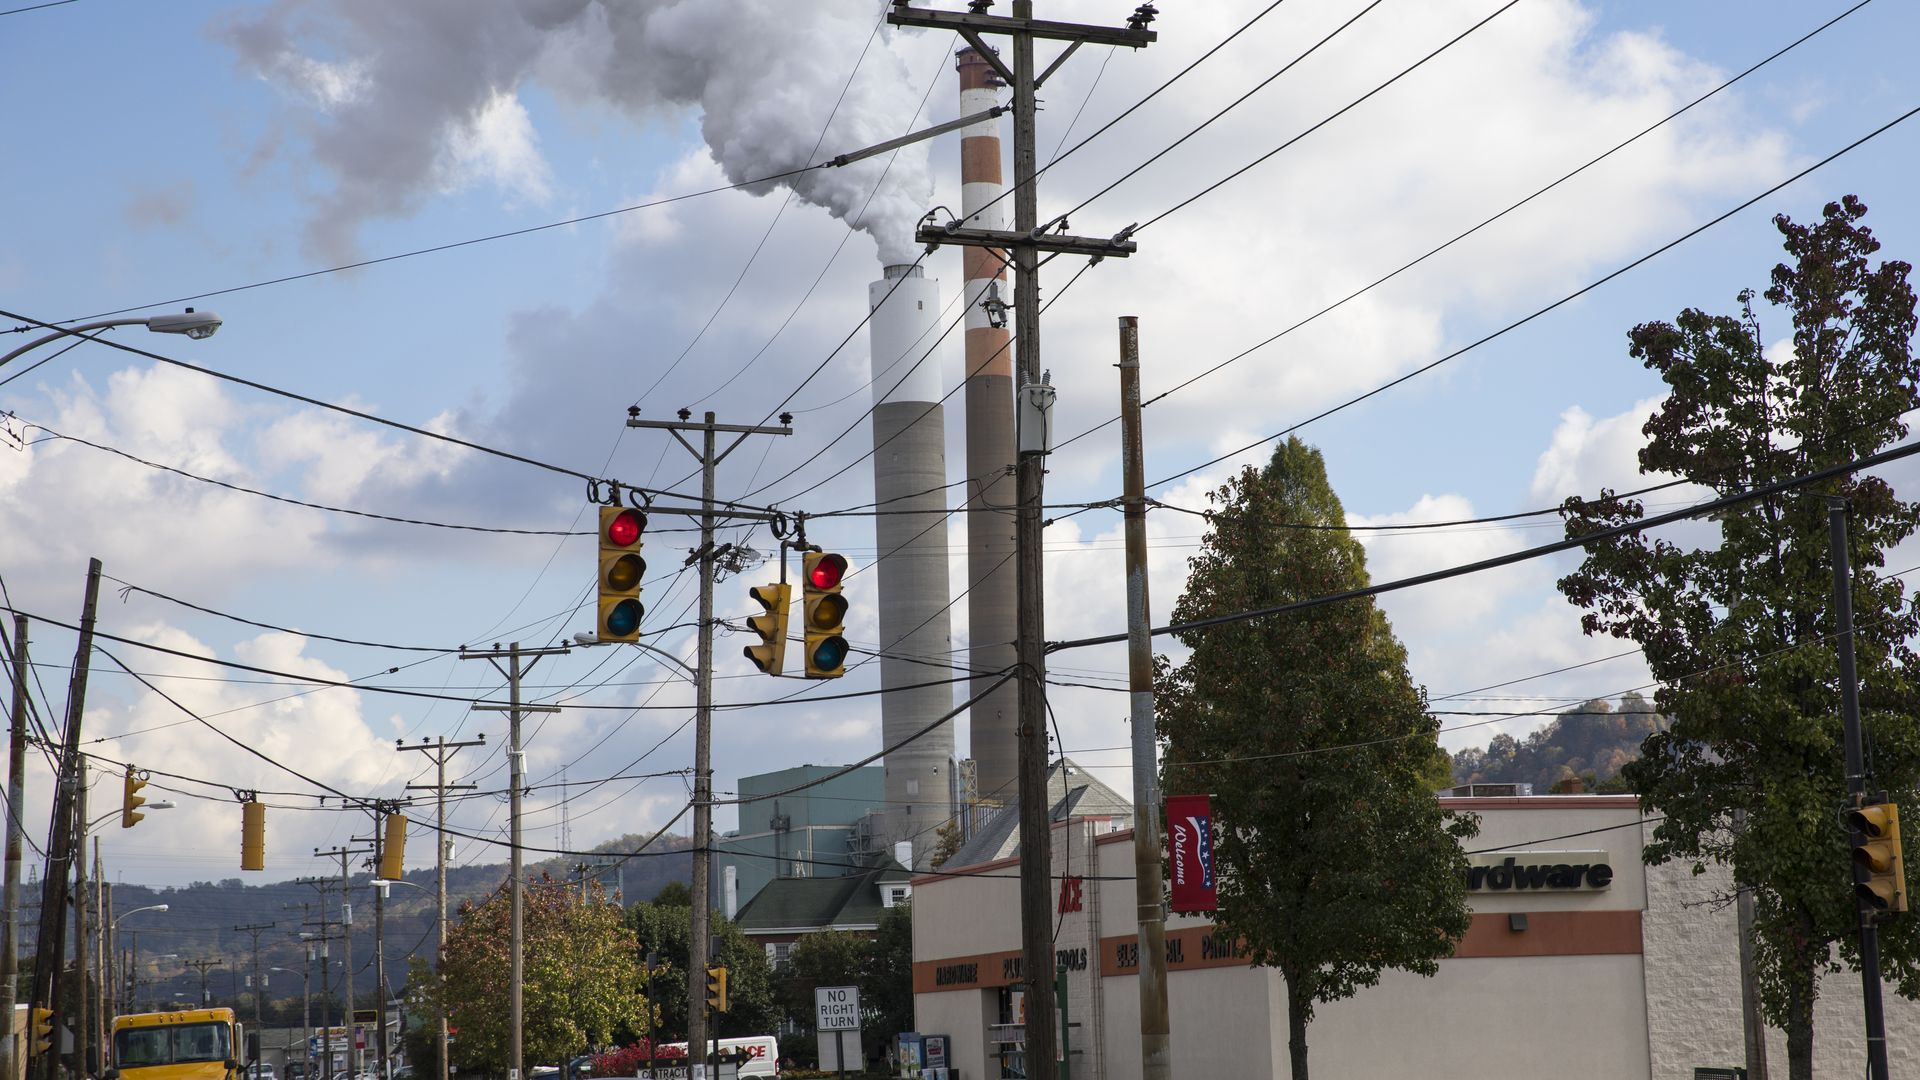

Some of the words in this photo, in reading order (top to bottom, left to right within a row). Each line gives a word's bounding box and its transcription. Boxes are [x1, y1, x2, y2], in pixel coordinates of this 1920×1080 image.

[1174, 824, 1187, 885] Welcome
[1058, 872, 1083, 914] ACE
[1056, 948, 1088, 971] TOOLS
[937, 963, 978, 986] HARDWARE
[828, 990, 846, 1002] NO
[820, 1004, 854, 1015] RIGHT
[824, 1016, 855, 1027] TURN
